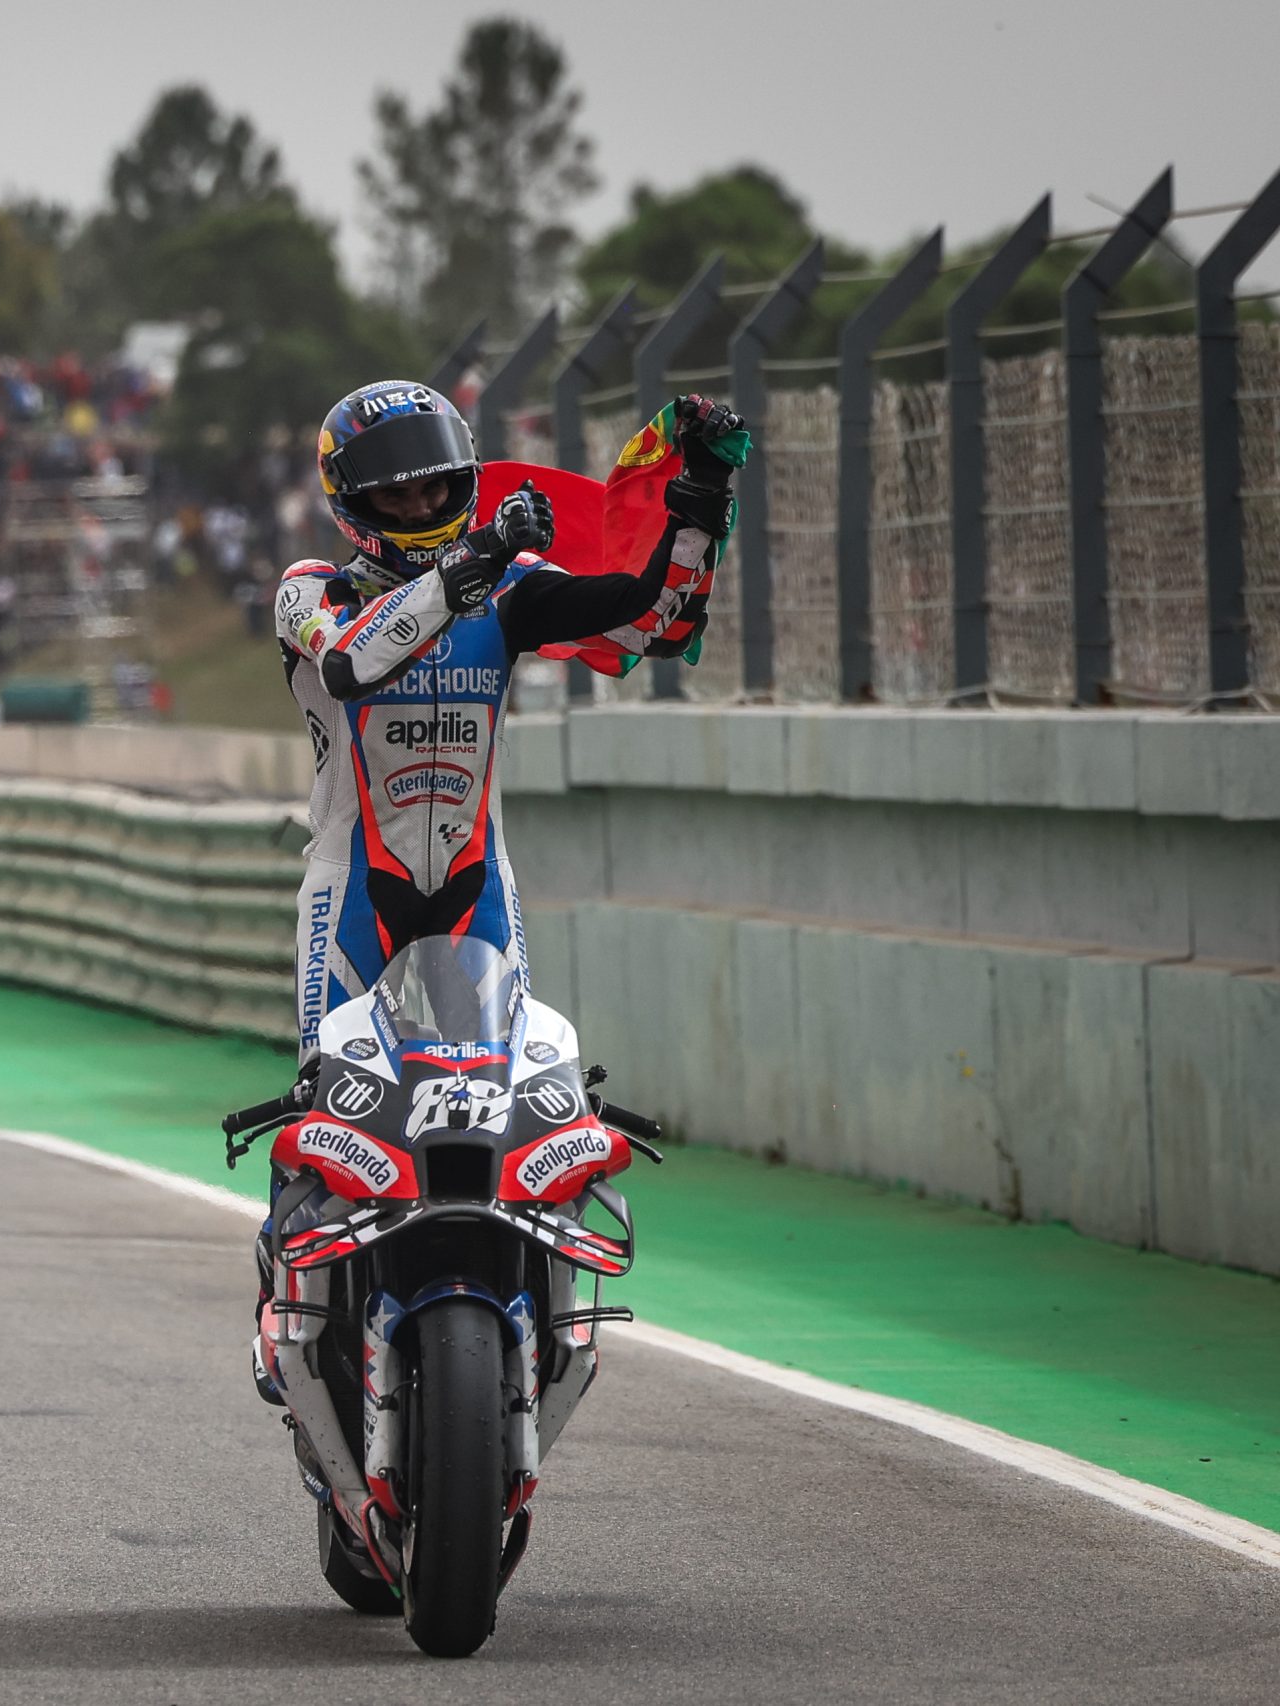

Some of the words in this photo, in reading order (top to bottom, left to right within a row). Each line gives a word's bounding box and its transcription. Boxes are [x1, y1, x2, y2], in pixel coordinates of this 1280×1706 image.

[411, 462, 454, 478] HYUNDAI
[358, 559, 403, 585] IXON
[376, 667, 501, 695] ACKHOUSE
[385, 711, 478, 749] aprilia
[415, 746, 478, 754] RACING
[391, 769, 468, 797] sterilgarda
[301, 885, 332, 1049] TRACKHOUSE
[423, 1041, 490, 1058] aprilia
[302, 1126, 391, 1186] sterilgarda
[523, 1130, 606, 1188] sterilgarda
[322, 1159, 355, 1181] alimenti
[559, 1165, 588, 1184] alimenti
